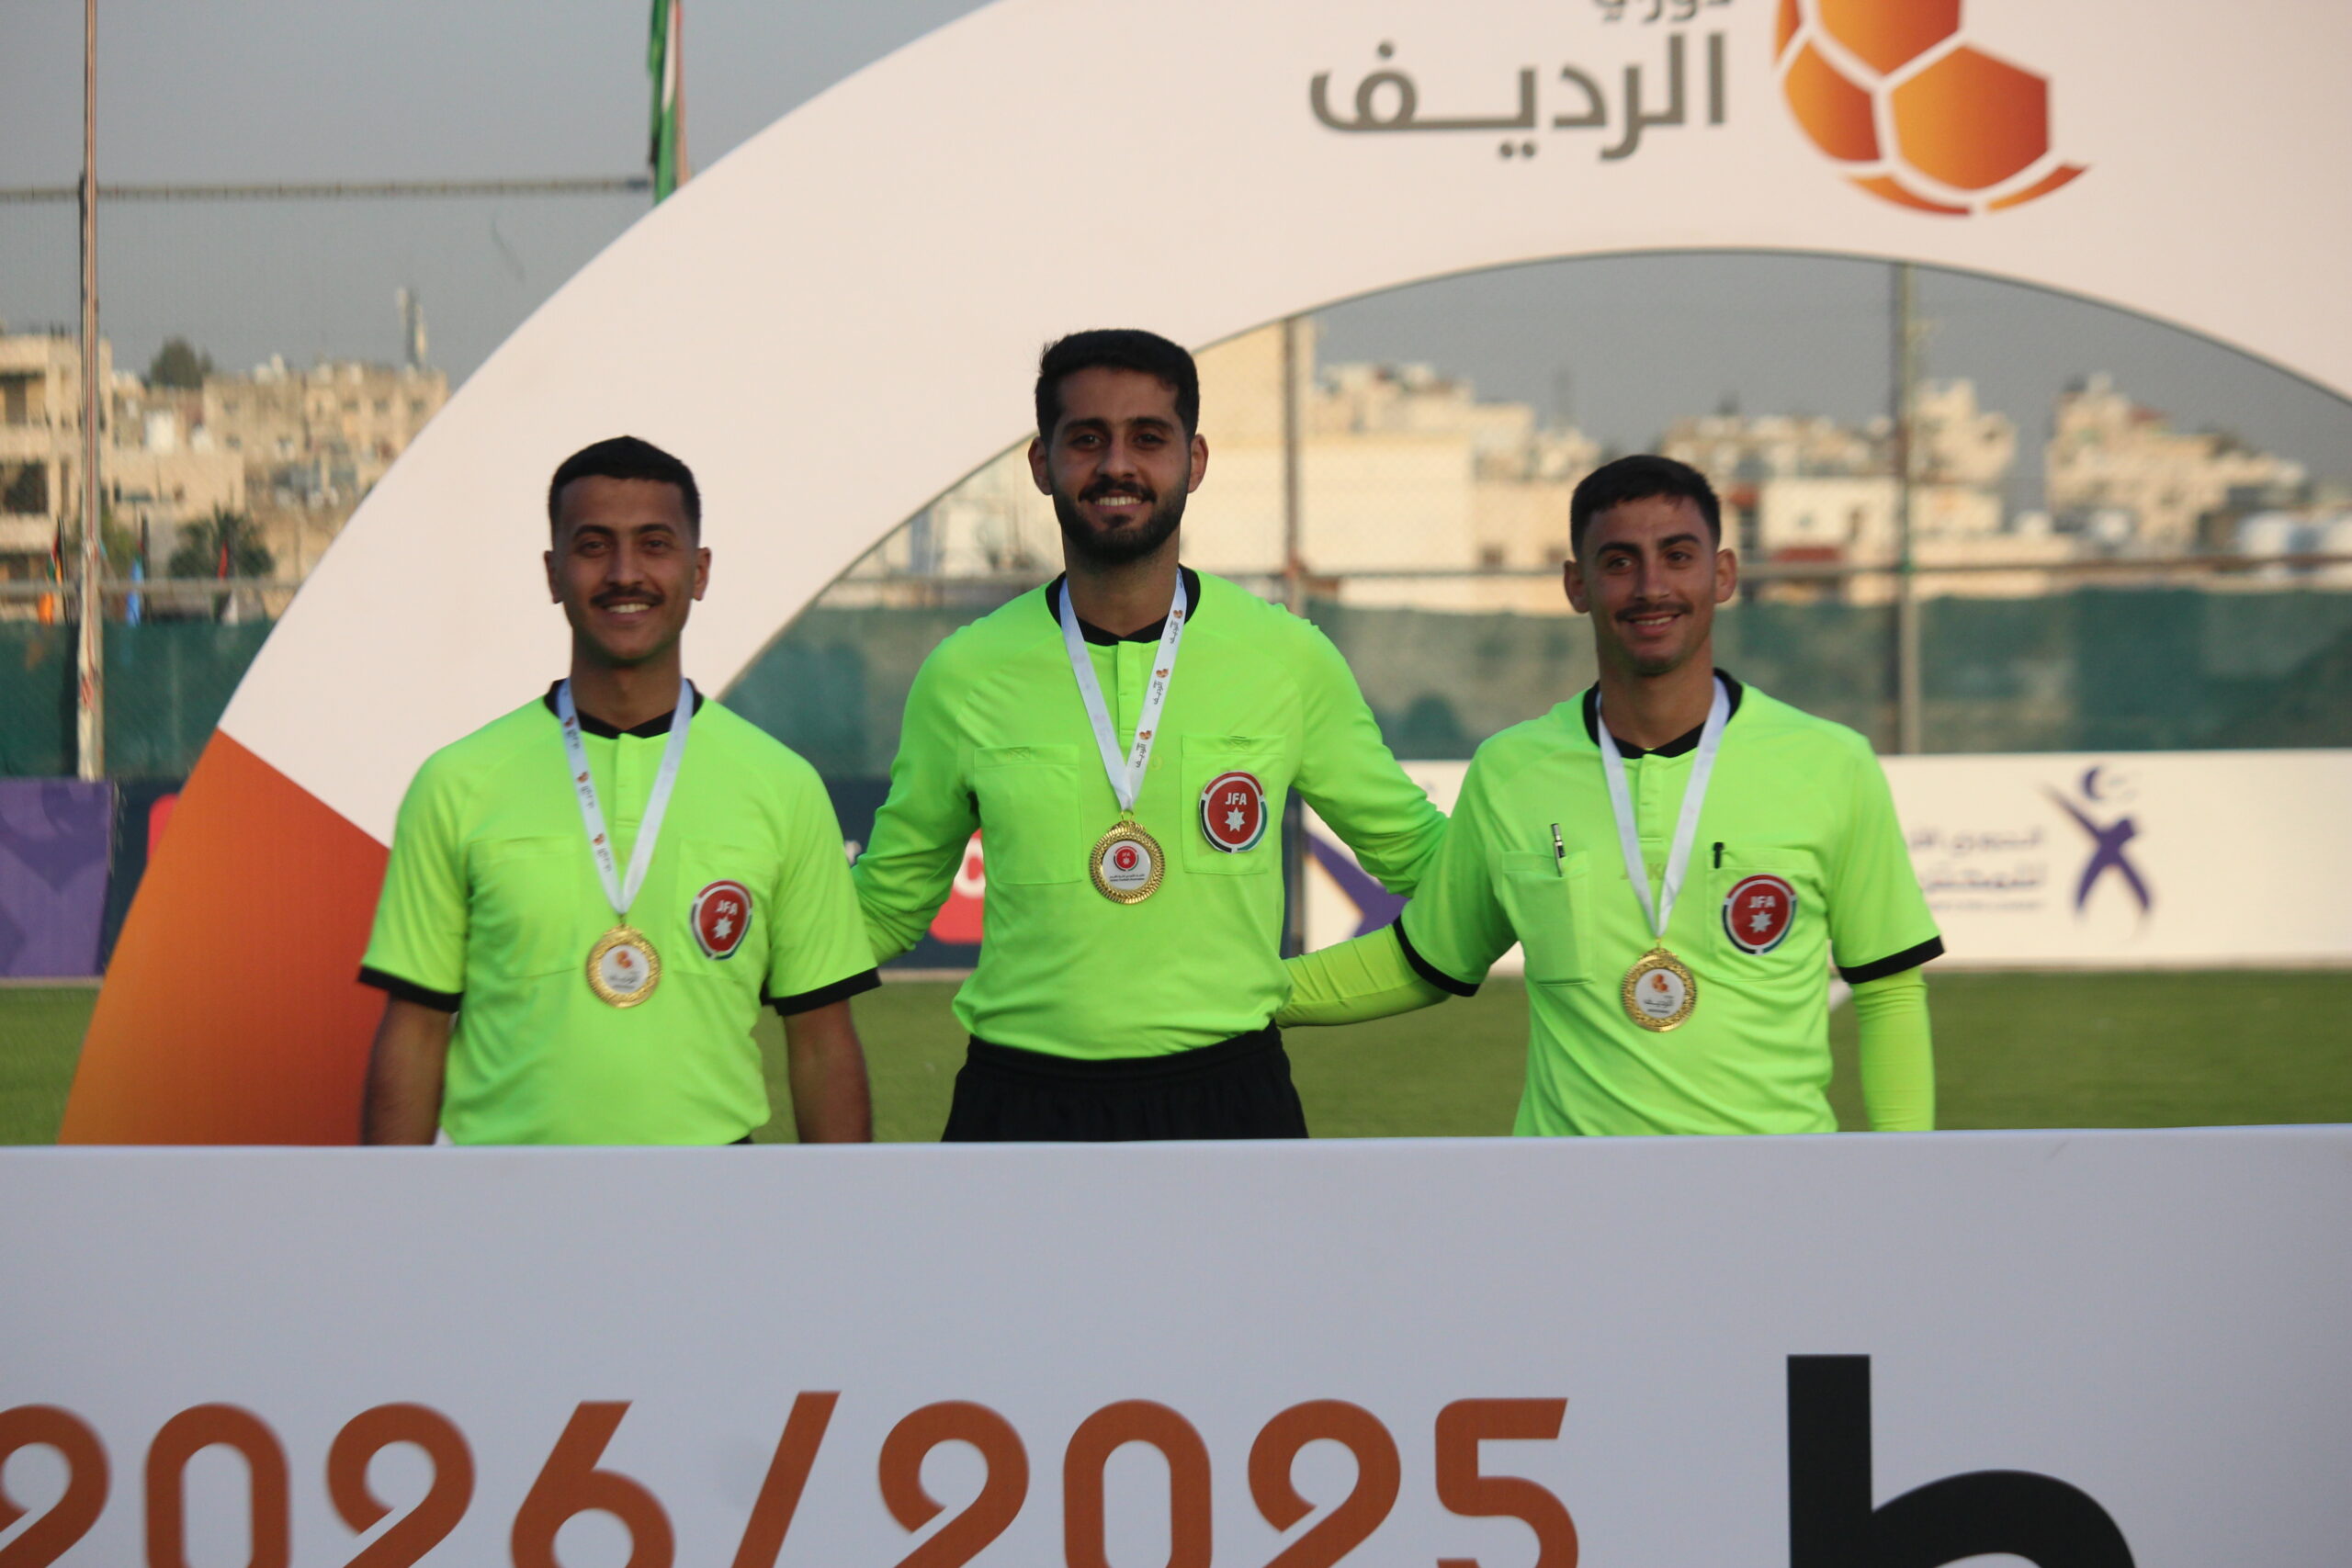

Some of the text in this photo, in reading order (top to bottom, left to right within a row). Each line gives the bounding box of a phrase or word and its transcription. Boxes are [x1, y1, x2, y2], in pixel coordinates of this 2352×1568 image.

[1309, 30, 1727, 162] الرديف
[1225, 792, 1248, 806] JFA
[716, 899, 738, 916] JFA
[1749, 895, 1776, 908] JFA
